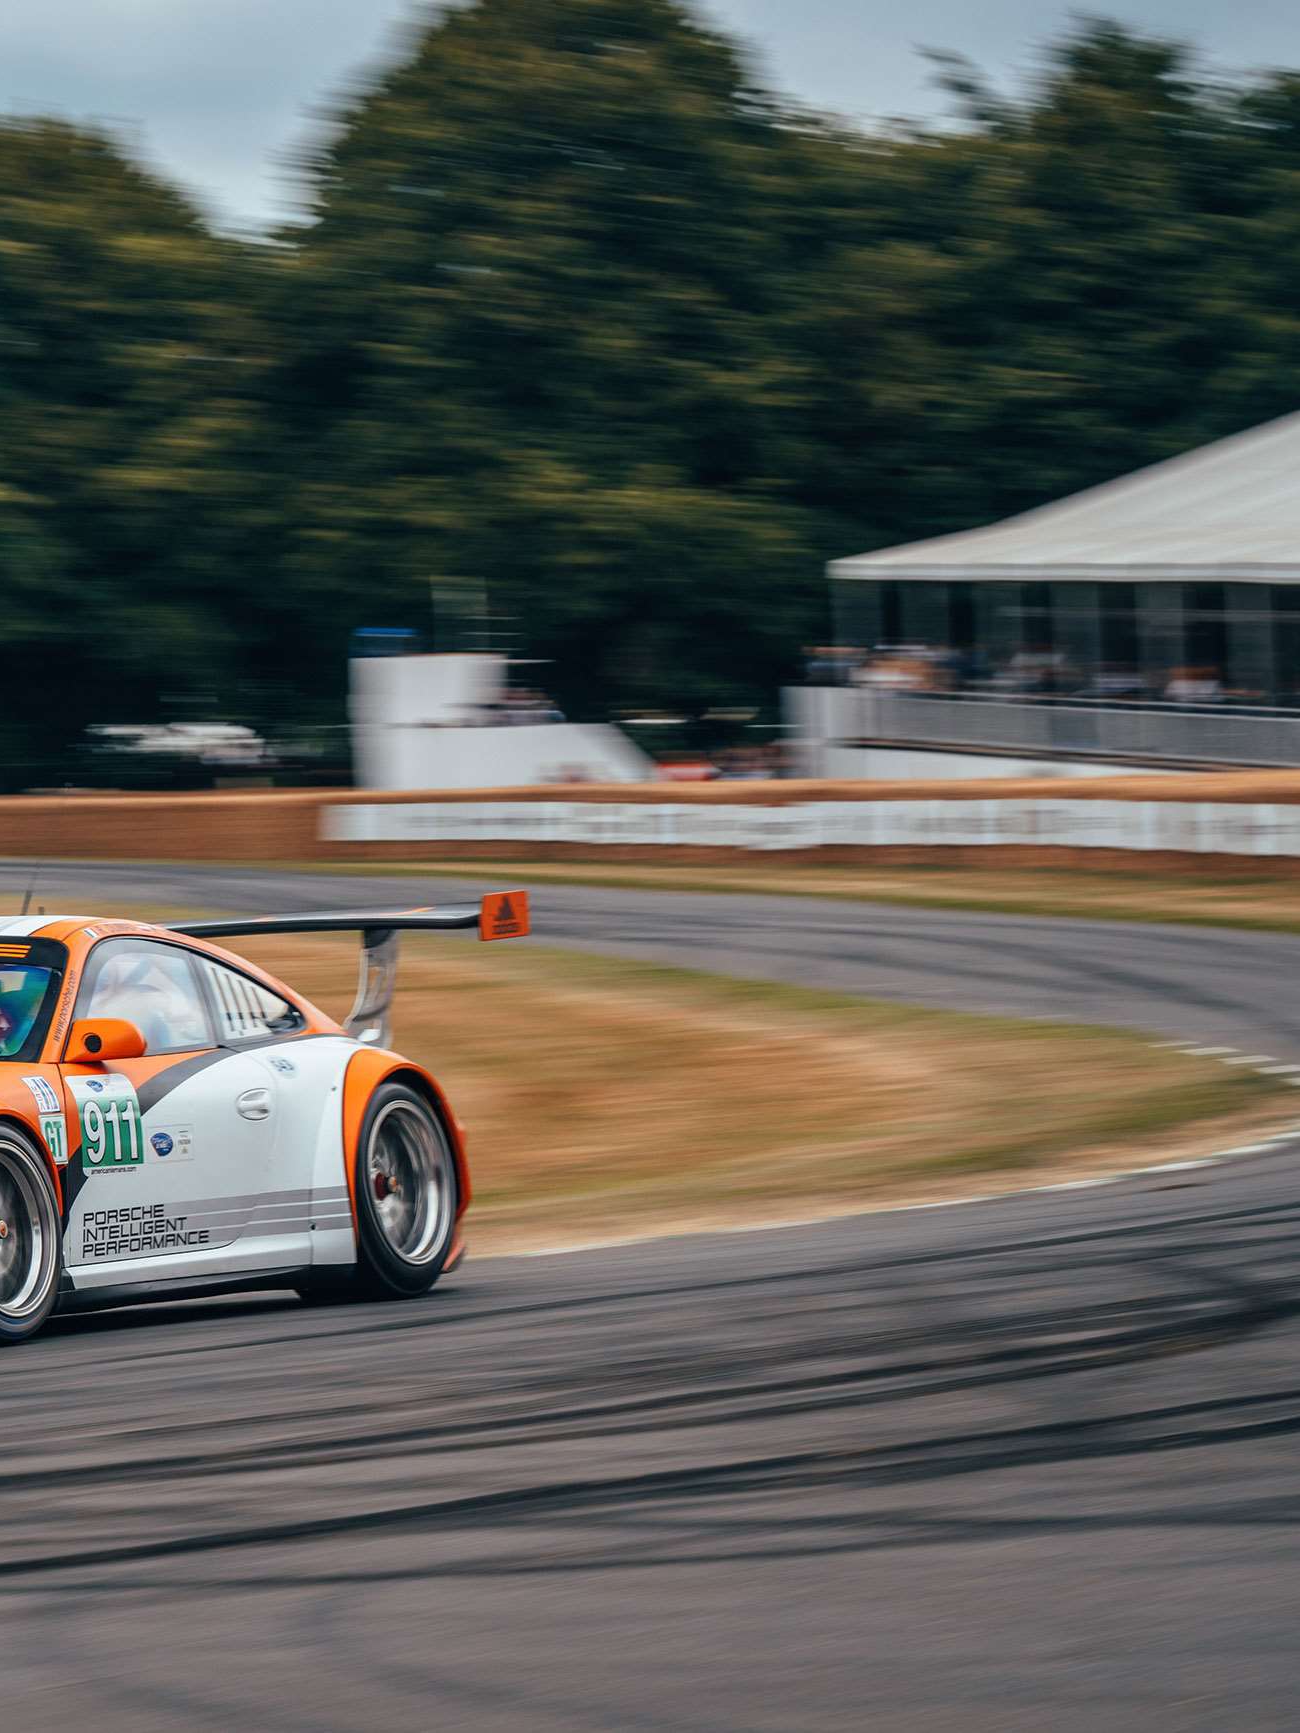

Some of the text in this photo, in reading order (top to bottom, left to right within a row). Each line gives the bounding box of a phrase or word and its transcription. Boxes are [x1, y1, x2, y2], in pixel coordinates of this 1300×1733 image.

[44, 1121, 63, 1158] GT
[83, 1100, 140, 1164] 911
[83, 1204, 164, 1227] PORSCHE
[83, 1217, 187, 1242] INTELLIGENT
[83, 1230, 209, 1258] PERFORMANCE
